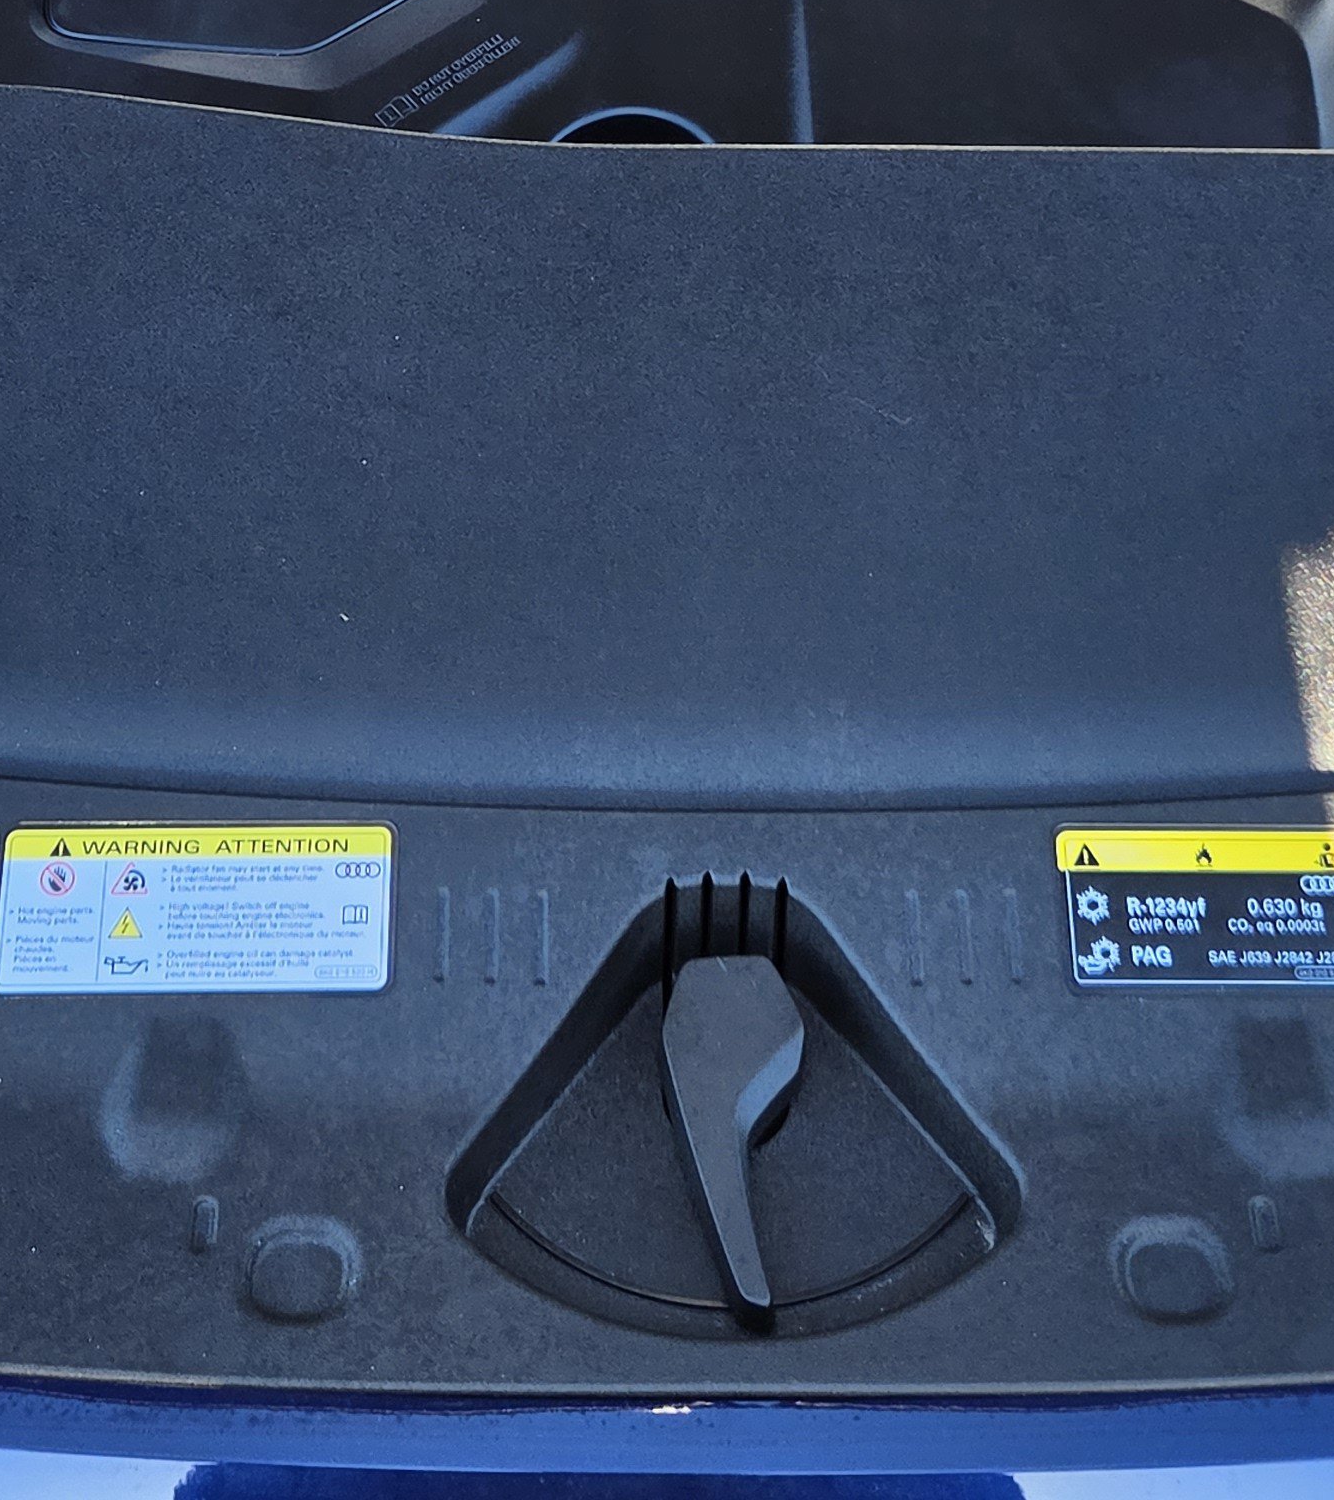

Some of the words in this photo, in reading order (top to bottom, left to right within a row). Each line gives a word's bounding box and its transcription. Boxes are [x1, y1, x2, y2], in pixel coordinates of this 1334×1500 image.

[83, 839, 200, 854] WARNING
[214, 838, 349, 853] ATTENTION
[18, 906, 35, 915] Hot
[37, 907, 67, 917] engine
[1126, 895, 1207, 919] R-1234yf
[1246, 897, 1296, 918] 0.630
[1300, 897, 1325, 920] kg
[1128, 918, 1164, 934] GWP
[1165, 918, 1201, 934] 0.501
[1276, 918, 1327, 934] 0.0003t
[1131, 945, 1172, 967] PAG
[1208, 950, 1237, 964] SAE
[1240, 950, 1272, 965] J639
[1274, 950, 1315, 965] J2842
